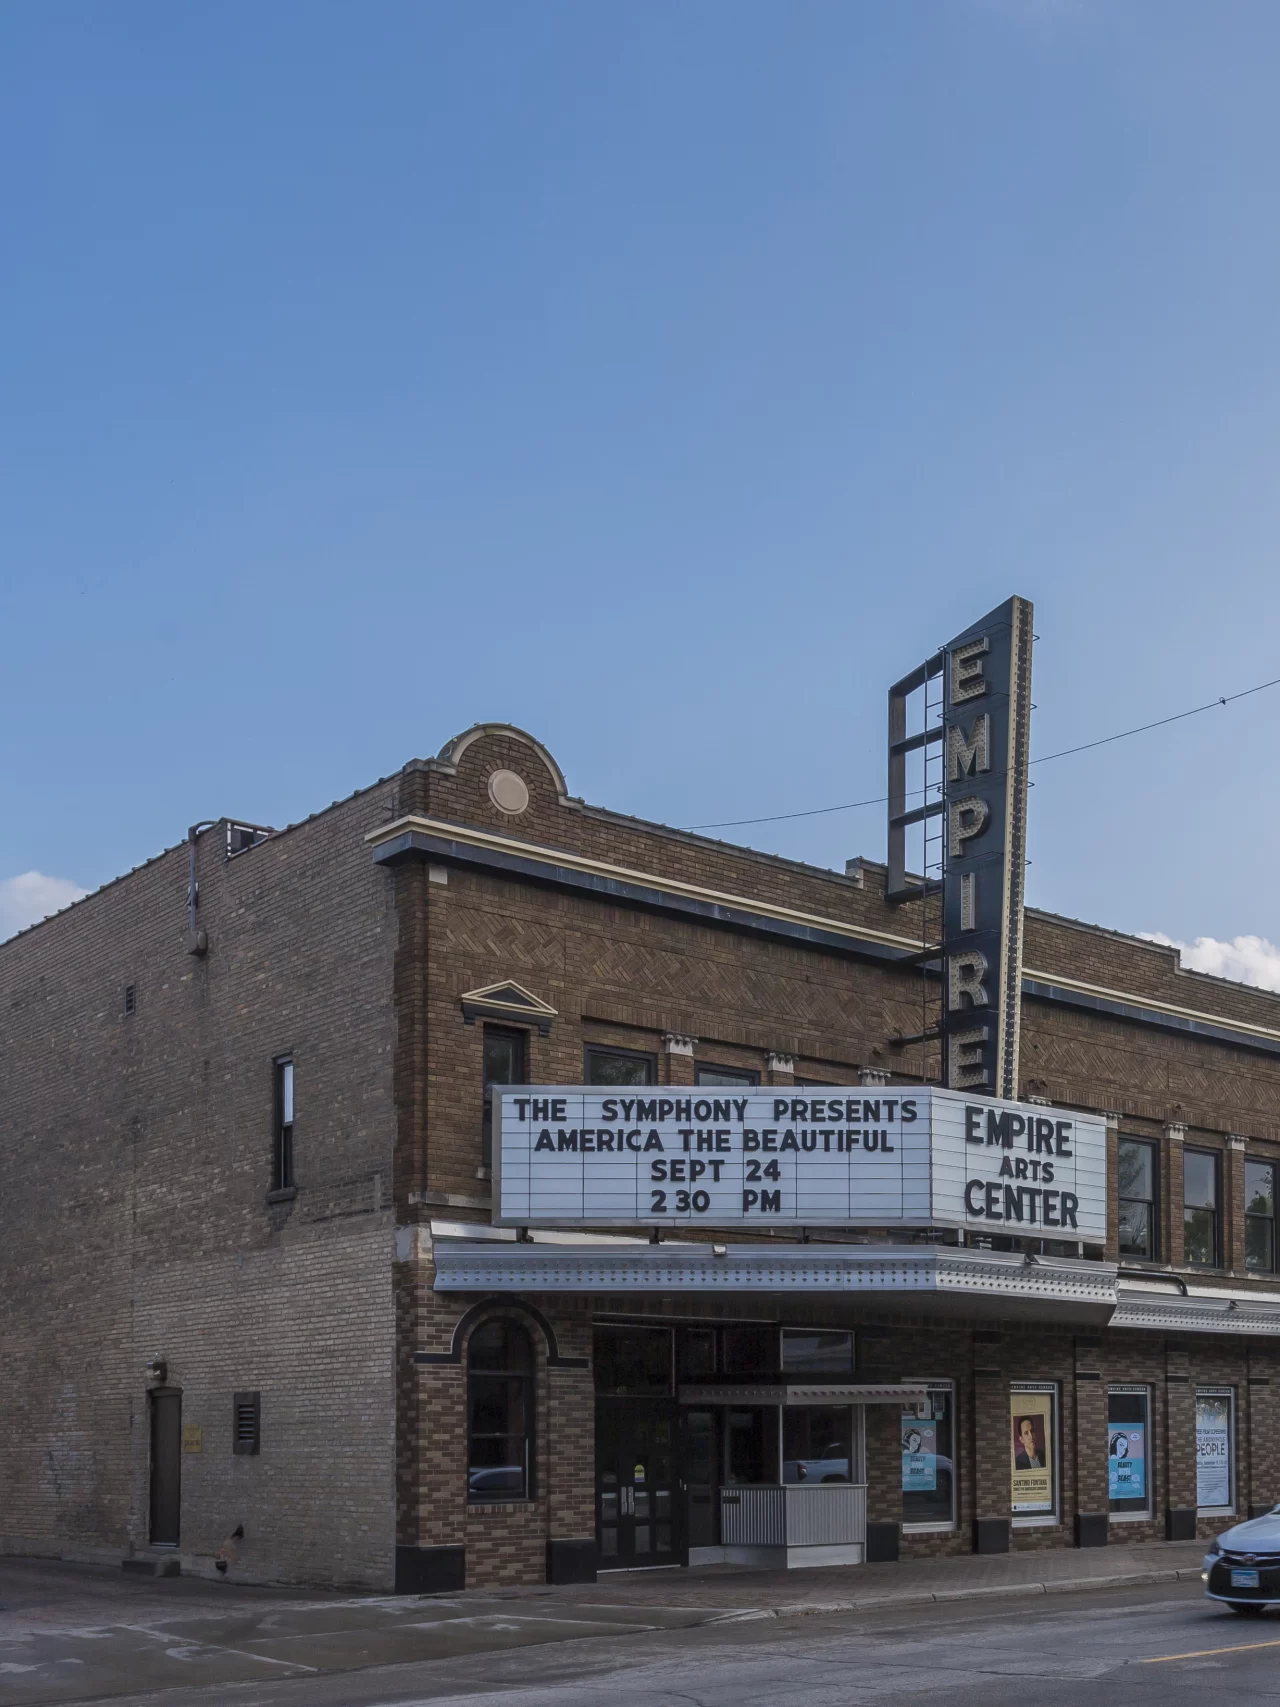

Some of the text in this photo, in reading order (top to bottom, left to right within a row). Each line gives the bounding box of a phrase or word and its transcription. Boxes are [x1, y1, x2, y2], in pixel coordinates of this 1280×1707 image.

[947, 636, 990, 1091] EMPIRE
[513, 1098, 918, 1123] THE SYMPHONY PRESENTS
[534, 1128, 895, 1153] AMERICA THE BEAUTIFUL
[965, 1105, 1073, 1157] EMPIRE
[650, 1159, 781, 1183] SEPT 24
[999, 1155, 1055, 1183] ARTS
[742, 1188, 782, 1213] PM
[963, 1179, 1079, 1229] CENTER
[1196, 1443, 1226, 1456] PEOPLE
[1013, 1479, 1031, 1487] SANTINO
